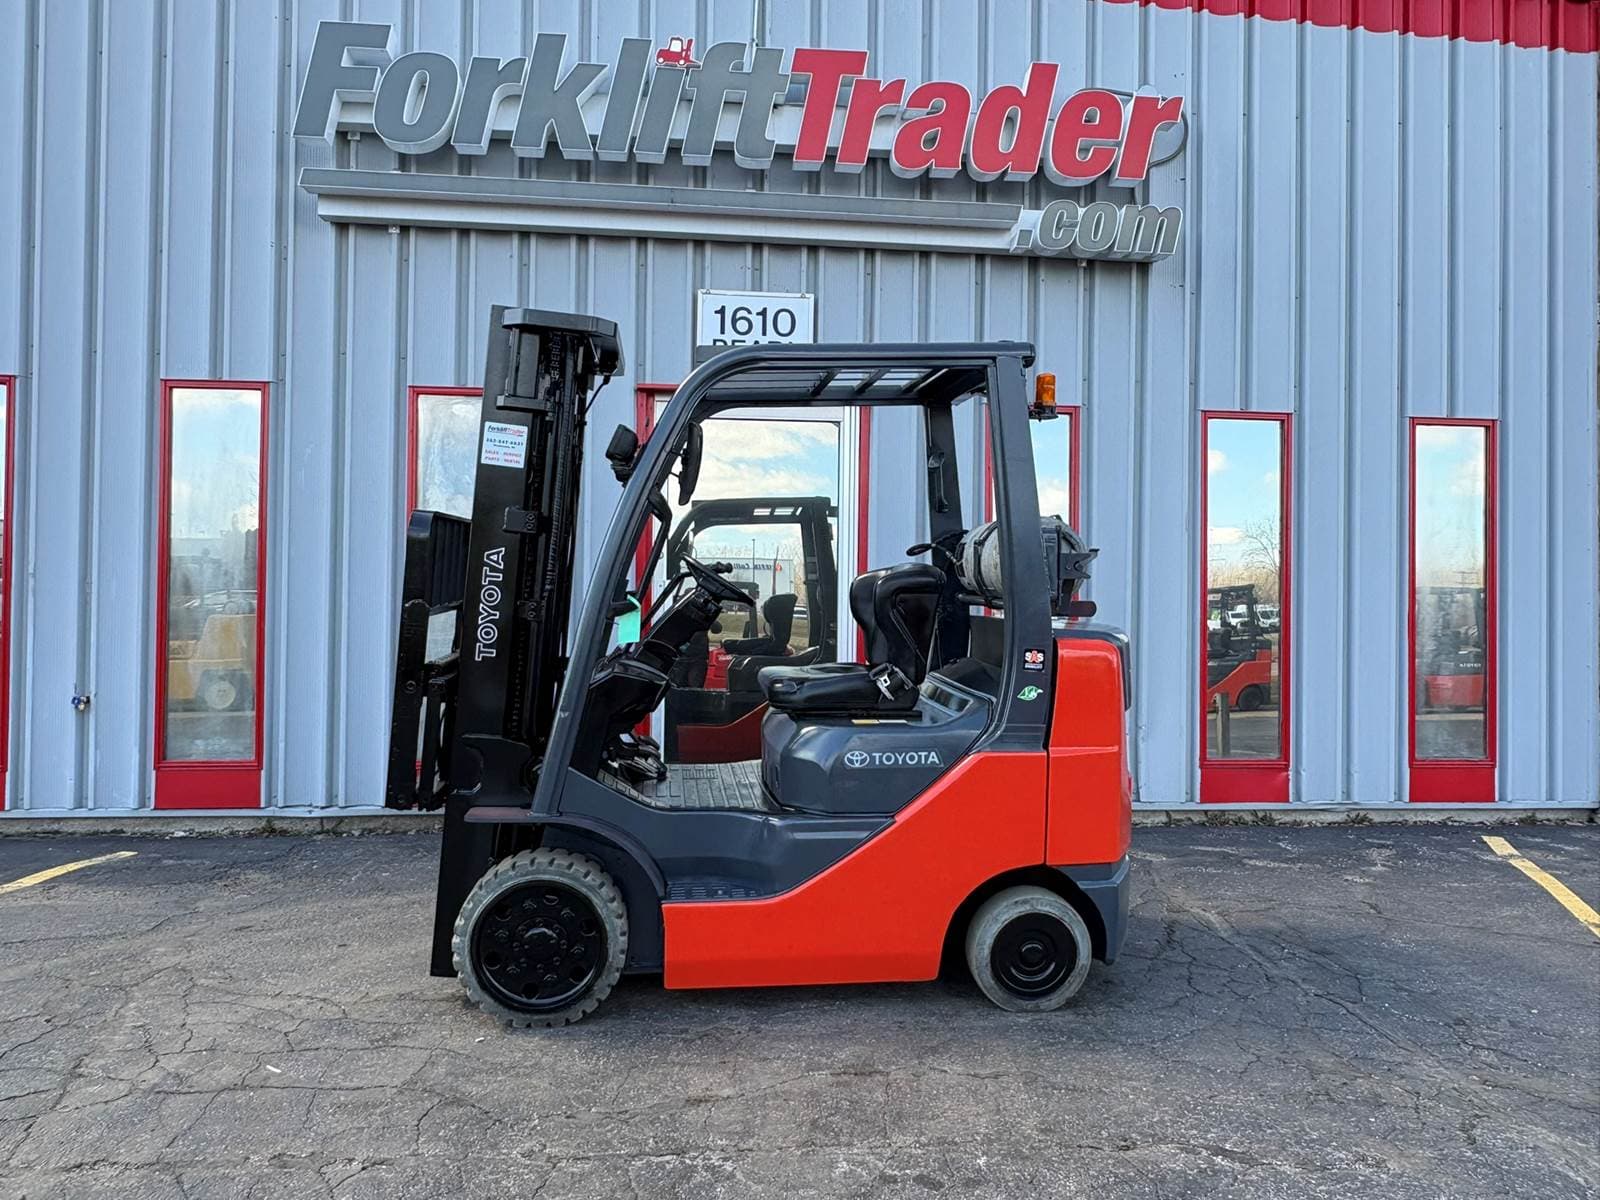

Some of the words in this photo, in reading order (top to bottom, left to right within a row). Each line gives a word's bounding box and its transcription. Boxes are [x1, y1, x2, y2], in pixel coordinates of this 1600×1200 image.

[1011, 199, 1184, 257] .com
[713, 304, 797, 337] 1610
[475, 547, 505, 661] TOYOTA
[872, 752, 940, 766] TOYOTA
